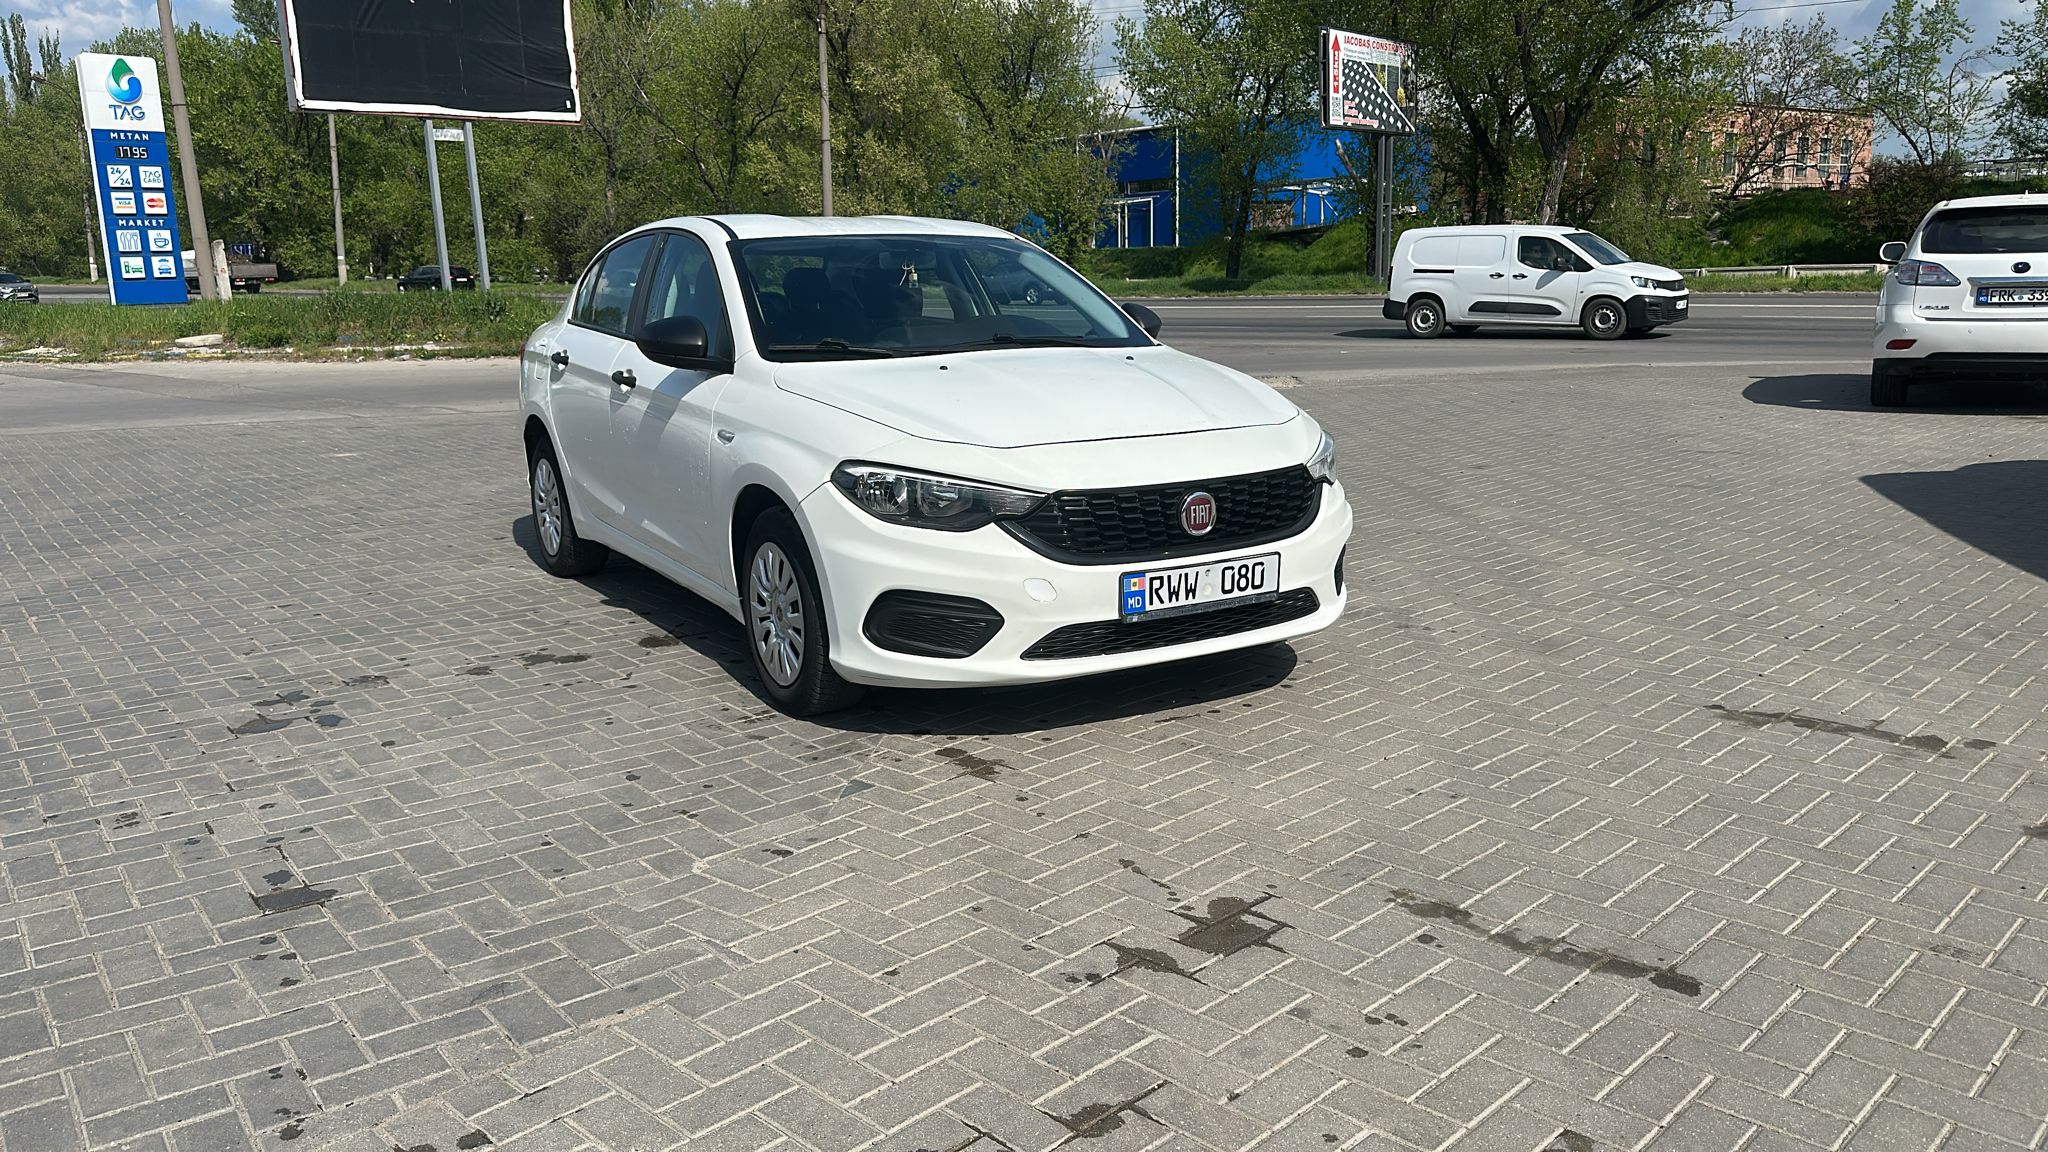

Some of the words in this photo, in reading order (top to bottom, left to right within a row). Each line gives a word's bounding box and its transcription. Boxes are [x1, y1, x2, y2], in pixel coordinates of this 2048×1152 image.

[109, 104, 146, 121] TAG
[110, 132, 149, 140] METAN
[143, 170, 161, 178] TAG
[1989, 289, 2017, 302] FRK
[1190, 503, 1211, 525] FIAT
[1149, 571, 1199, 606] RWW
[1221, 561, 1265, 595] 080
[1128, 596, 1142, 609] MD
